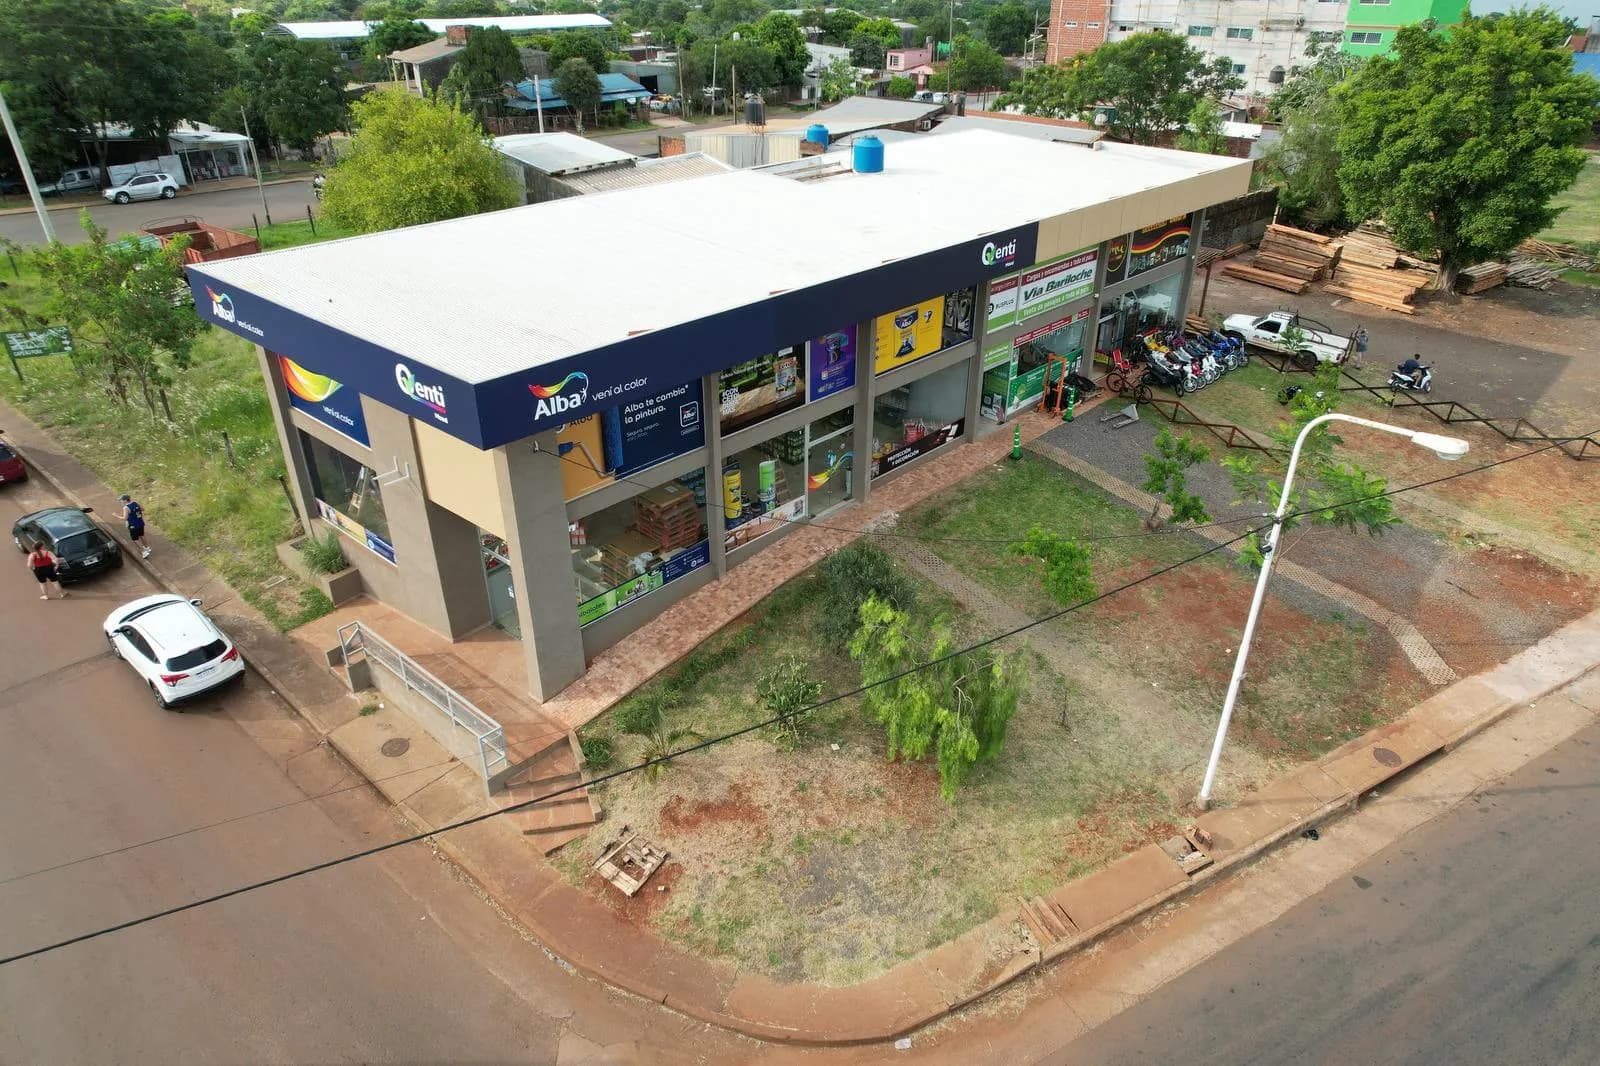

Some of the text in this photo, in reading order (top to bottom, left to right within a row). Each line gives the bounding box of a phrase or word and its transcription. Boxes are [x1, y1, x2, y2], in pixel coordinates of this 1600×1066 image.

[1023, 268, 1093, 301] Via Bariloche
[592, 376, 649, 401] vení al color
[534, 392, 583, 421] Alba
[624, 400, 645, 415] Alba
[645, 397, 655, 408] te
[624, 416, 634, 425] la
[635, 405, 667, 423] pintura.
